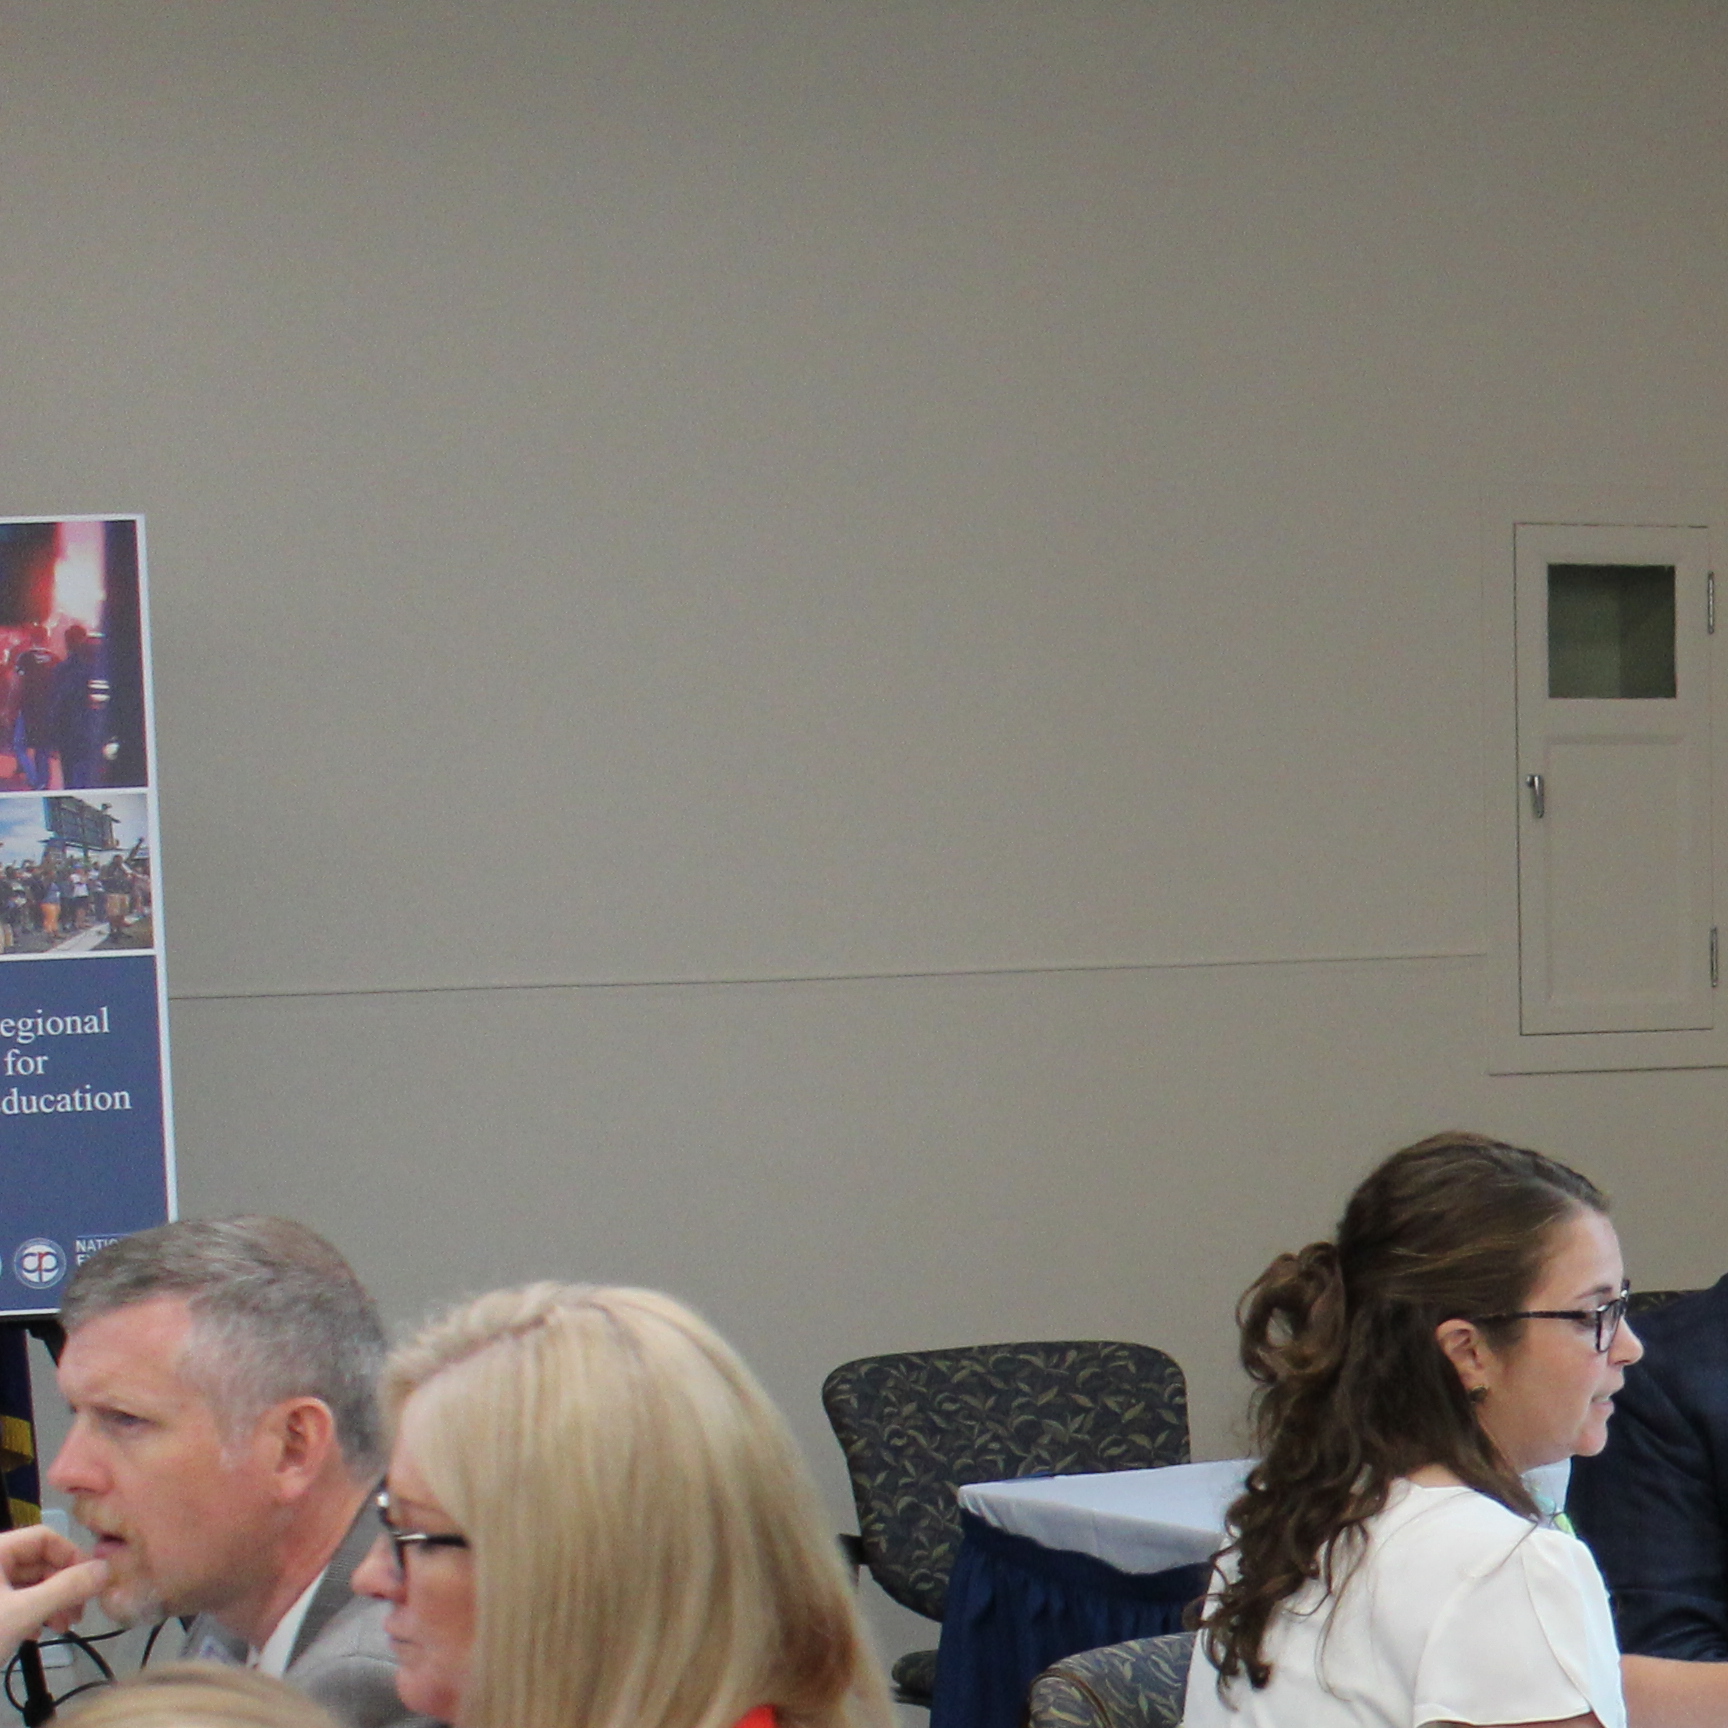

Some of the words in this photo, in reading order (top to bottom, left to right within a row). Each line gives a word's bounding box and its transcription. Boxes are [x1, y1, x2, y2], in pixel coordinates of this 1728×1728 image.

[0, 1006, 109, 1044] egional
[4, 1048, 49, 1076] for
[0, 1084, 132, 1114] ducation
[75, 1238, 118, 1252] NATI
